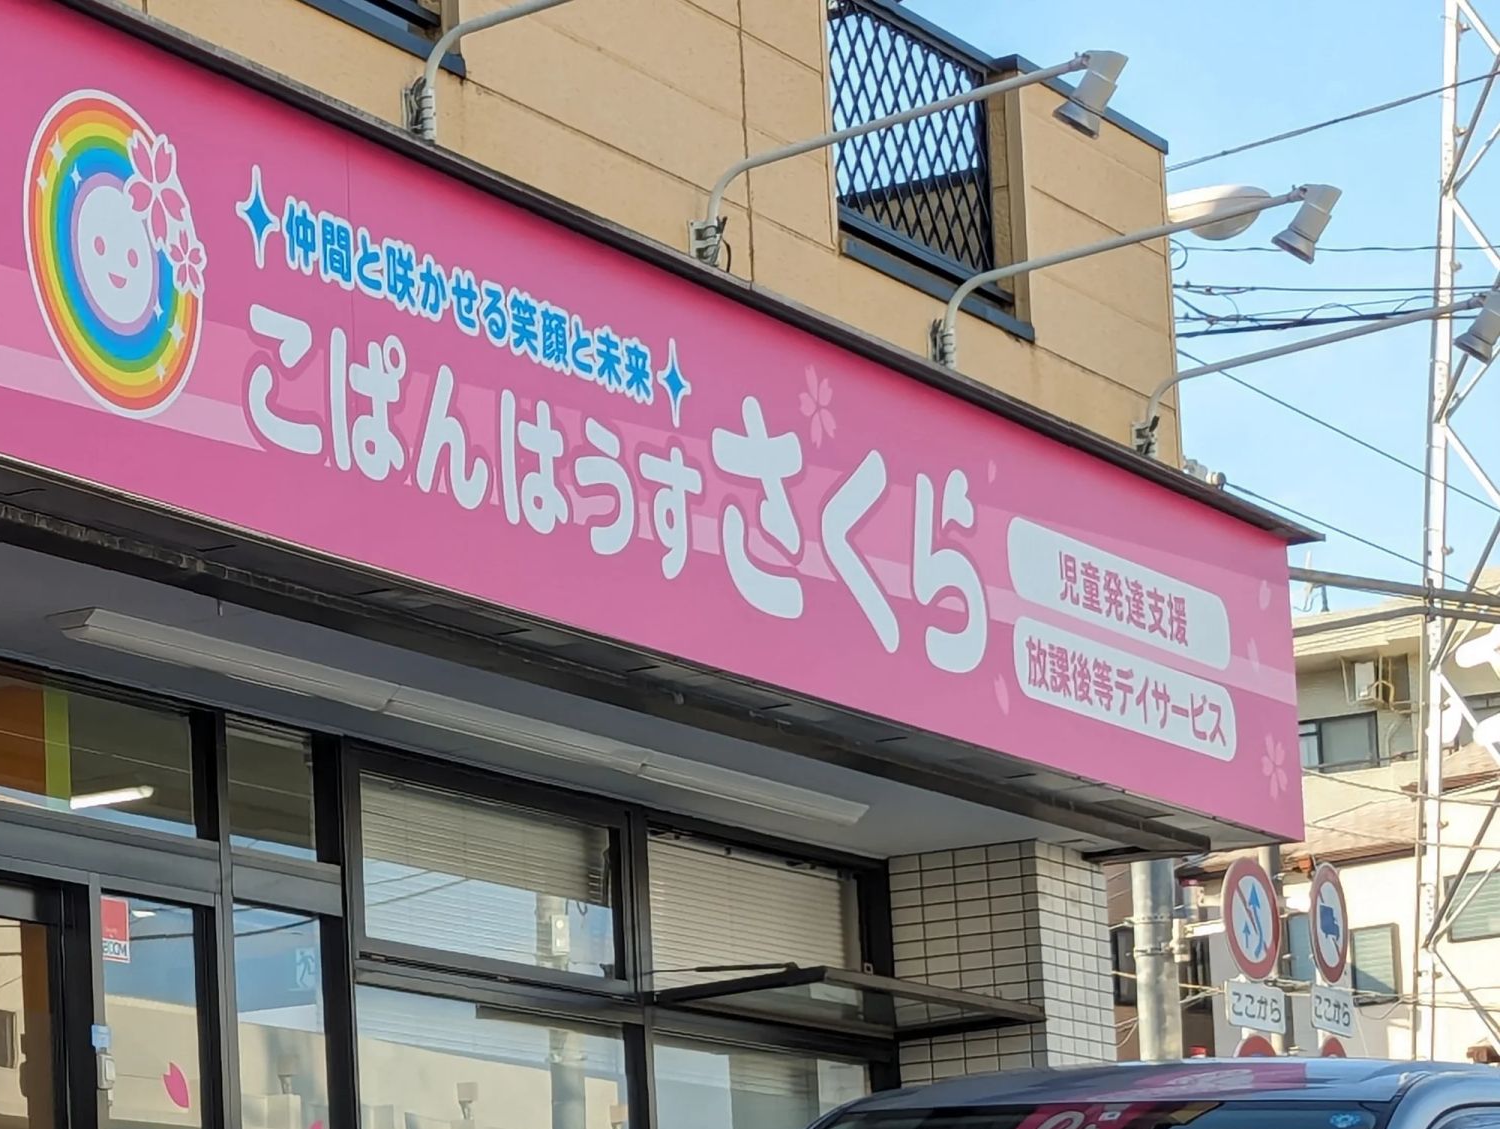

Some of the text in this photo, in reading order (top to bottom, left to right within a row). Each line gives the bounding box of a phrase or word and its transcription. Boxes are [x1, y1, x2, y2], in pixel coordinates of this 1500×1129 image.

[284, 198, 653, 405] 仲間と咲かせる笑顔と未来
[249, 305, 987, 674] こぱんはうすさくら
[1059, 551, 1188, 647] 児童発達支援
[1027, 636, 1227, 746] 放課後等デイサービス
[1231, 991, 1282, 1024] ここから
[1314, 994, 1351, 1027] ここから
